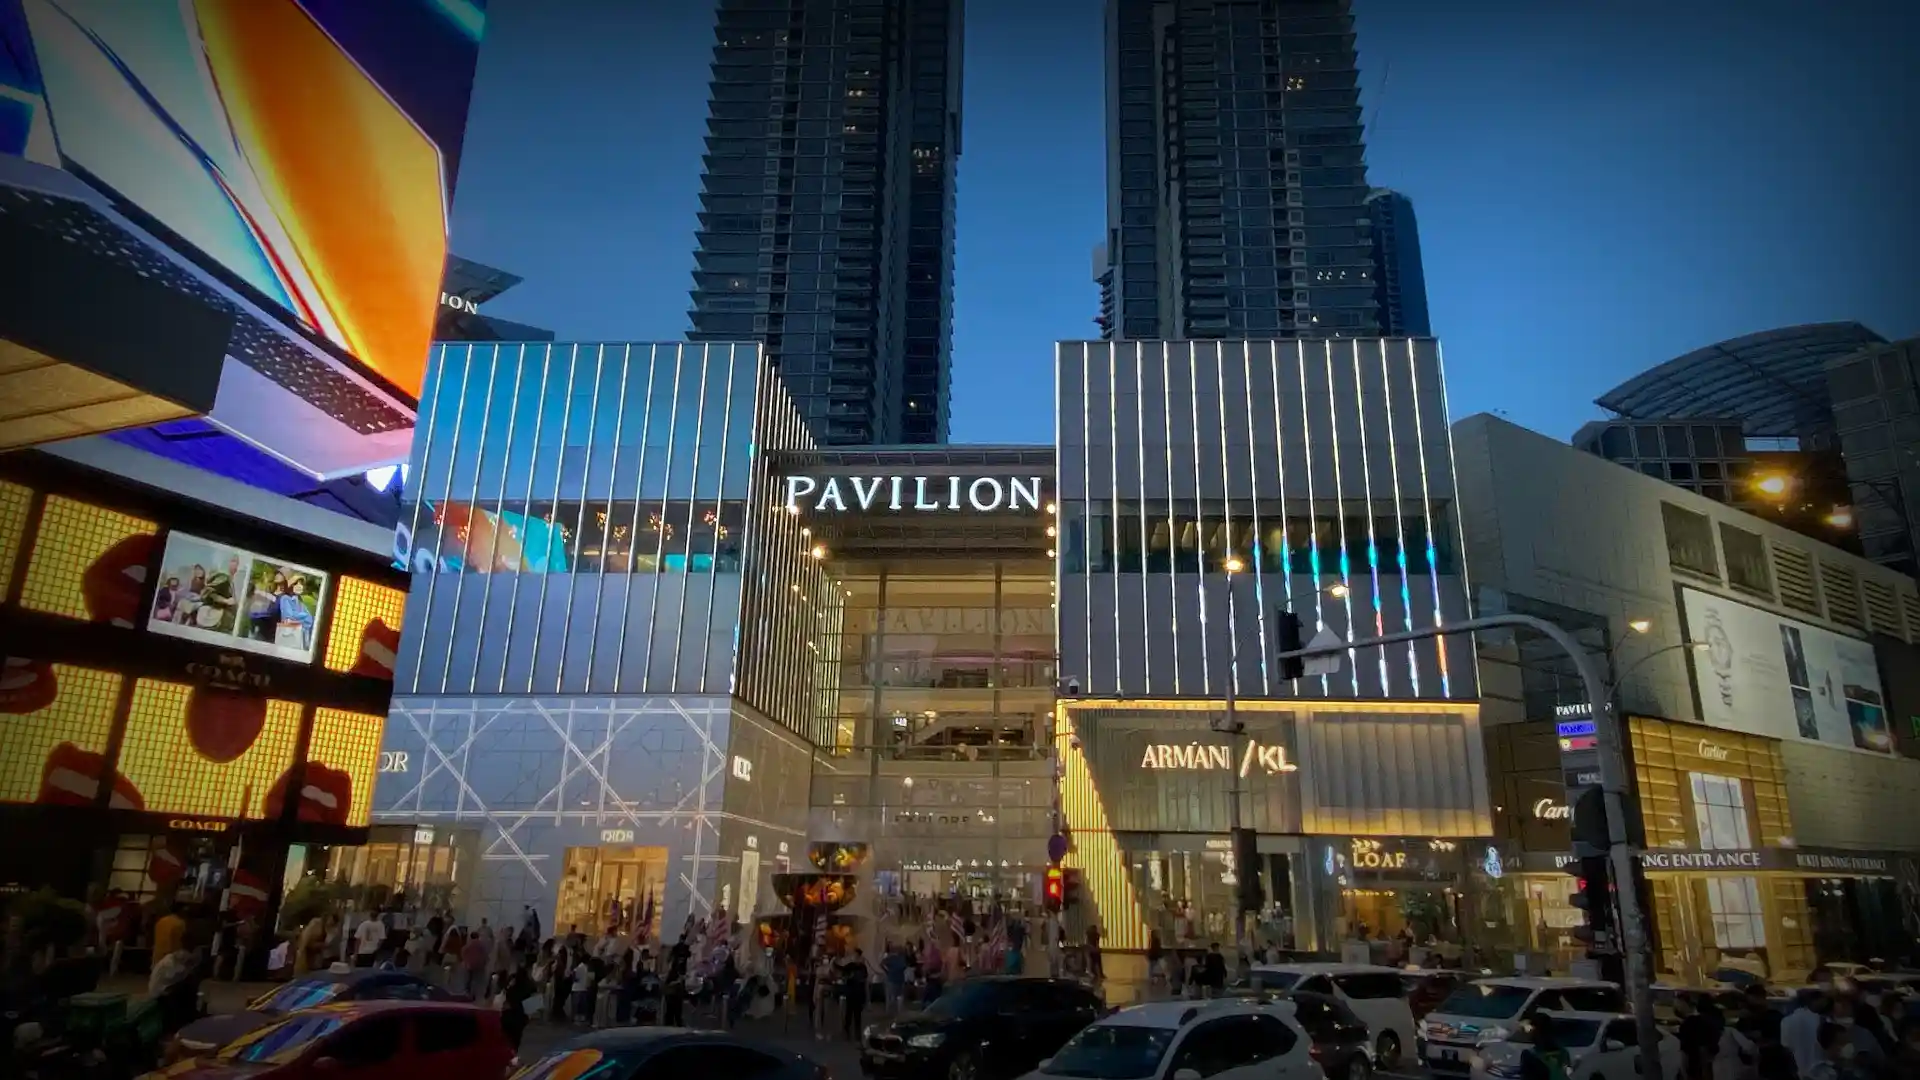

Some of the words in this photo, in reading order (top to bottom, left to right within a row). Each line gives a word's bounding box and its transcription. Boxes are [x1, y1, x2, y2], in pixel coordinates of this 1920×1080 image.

[785, 476, 1041, 511] PAVILION
[1353, 851, 1406, 868] LOAF
[1672, 852, 1761, 867] ENTRANCE
